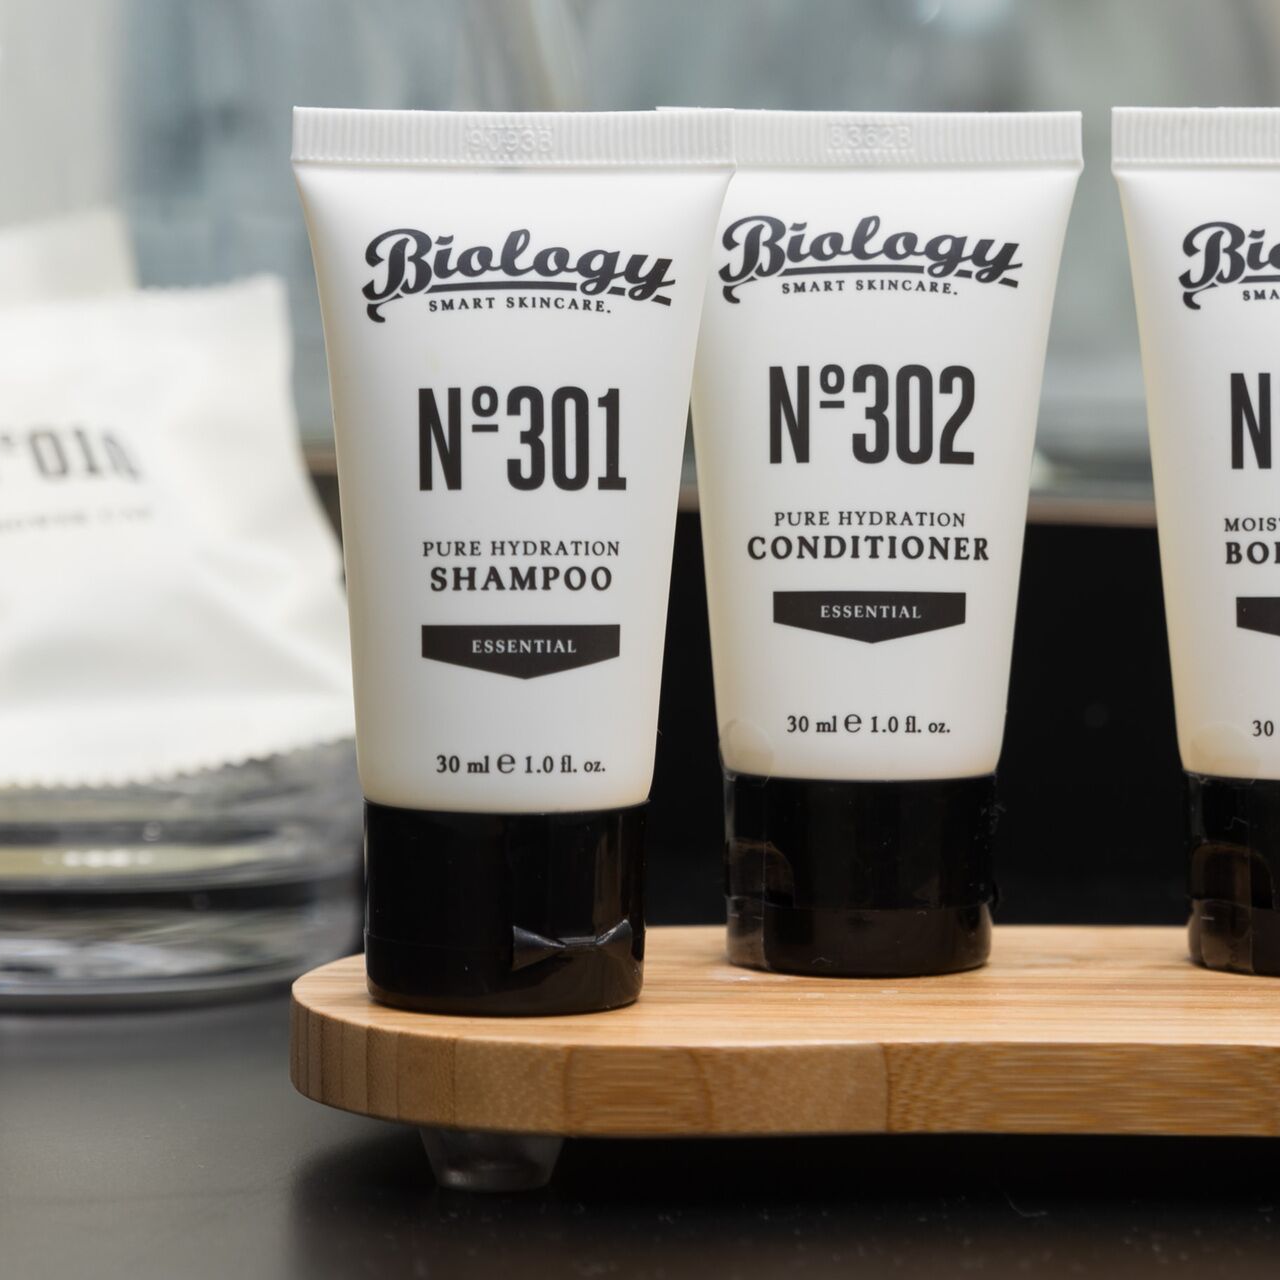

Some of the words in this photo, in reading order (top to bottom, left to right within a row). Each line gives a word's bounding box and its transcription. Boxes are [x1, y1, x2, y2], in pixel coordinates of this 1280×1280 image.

[718, 215, 1023, 305] Biology
[361, 228, 676, 324] Biology
[781, 280, 845, 294] SMART
[855, 279, 958, 296] SKINCARE.
[428, 297, 495, 313] SMART
[506, 296, 611, 314] SKINCARE.
[774, 511, 830, 527] PURE
[838, 510, 965, 528] HYDRATION
[422, 540, 482, 558] PURE
[490, 540, 620, 557] HYDRATION
[746, 535, 990, 561] CONDITIONER
[430, 565, 612, 593] SHAMPOO
[820, 605, 921, 619] ESSENTIAL
[472, 639, 577, 654] ESSENTIAL
[786, 714, 810, 734] 30
[815, 715, 838, 733] ml
[870, 715, 899, 734] 1.0
[904, 715, 922, 734] fl.
[927, 722, 951, 734] oz.
[1252, 719, 1275, 738] 30
[435, 753, 461, 774] 30
[466, 754, 491, 774] ml
[524, 755, 555, 774] 1.0
[560, 754, 578, 774] fl.
[583, 761, 606, 773] oz.
